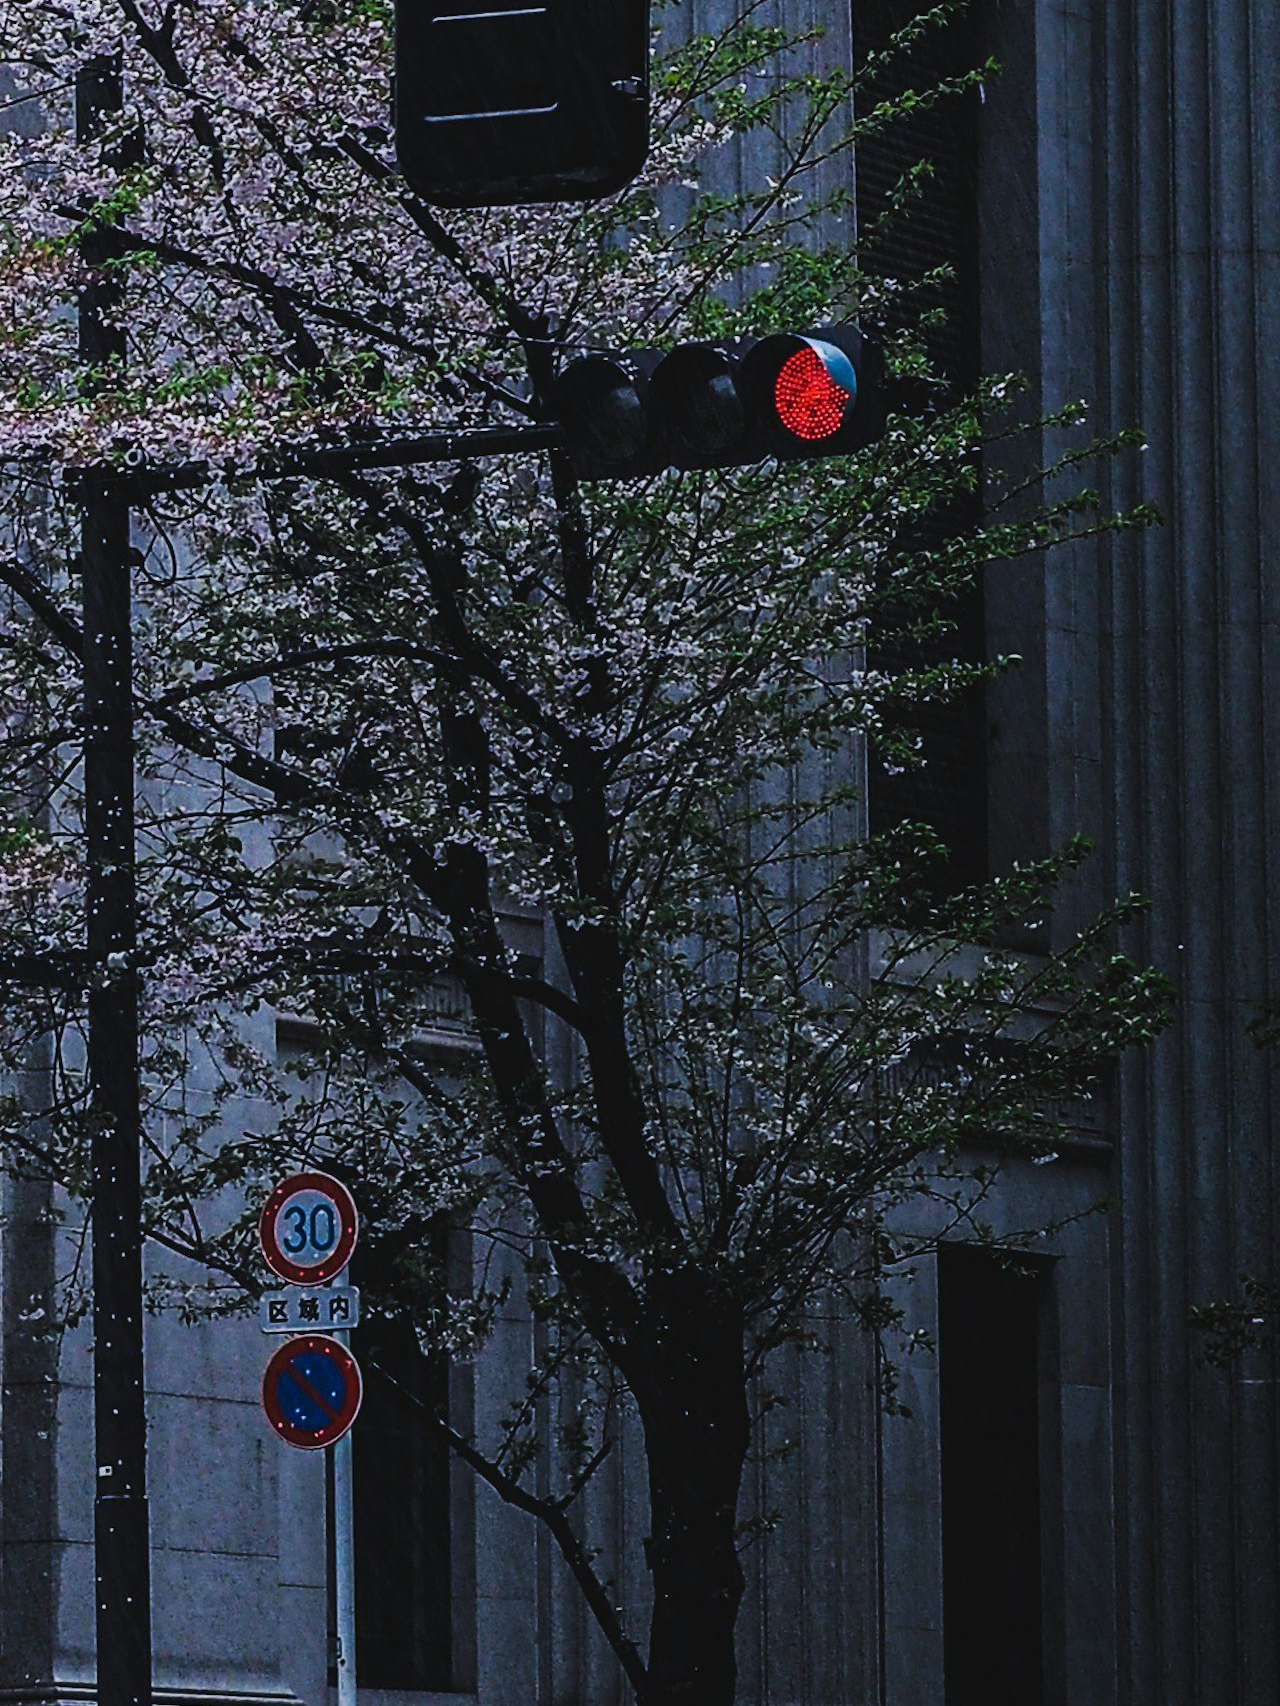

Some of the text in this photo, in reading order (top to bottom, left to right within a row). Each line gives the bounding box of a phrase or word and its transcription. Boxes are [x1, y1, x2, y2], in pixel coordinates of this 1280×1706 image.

[284, 1205, 335, 1253] 30
[269, 1296, 348, 1323] 区域内
